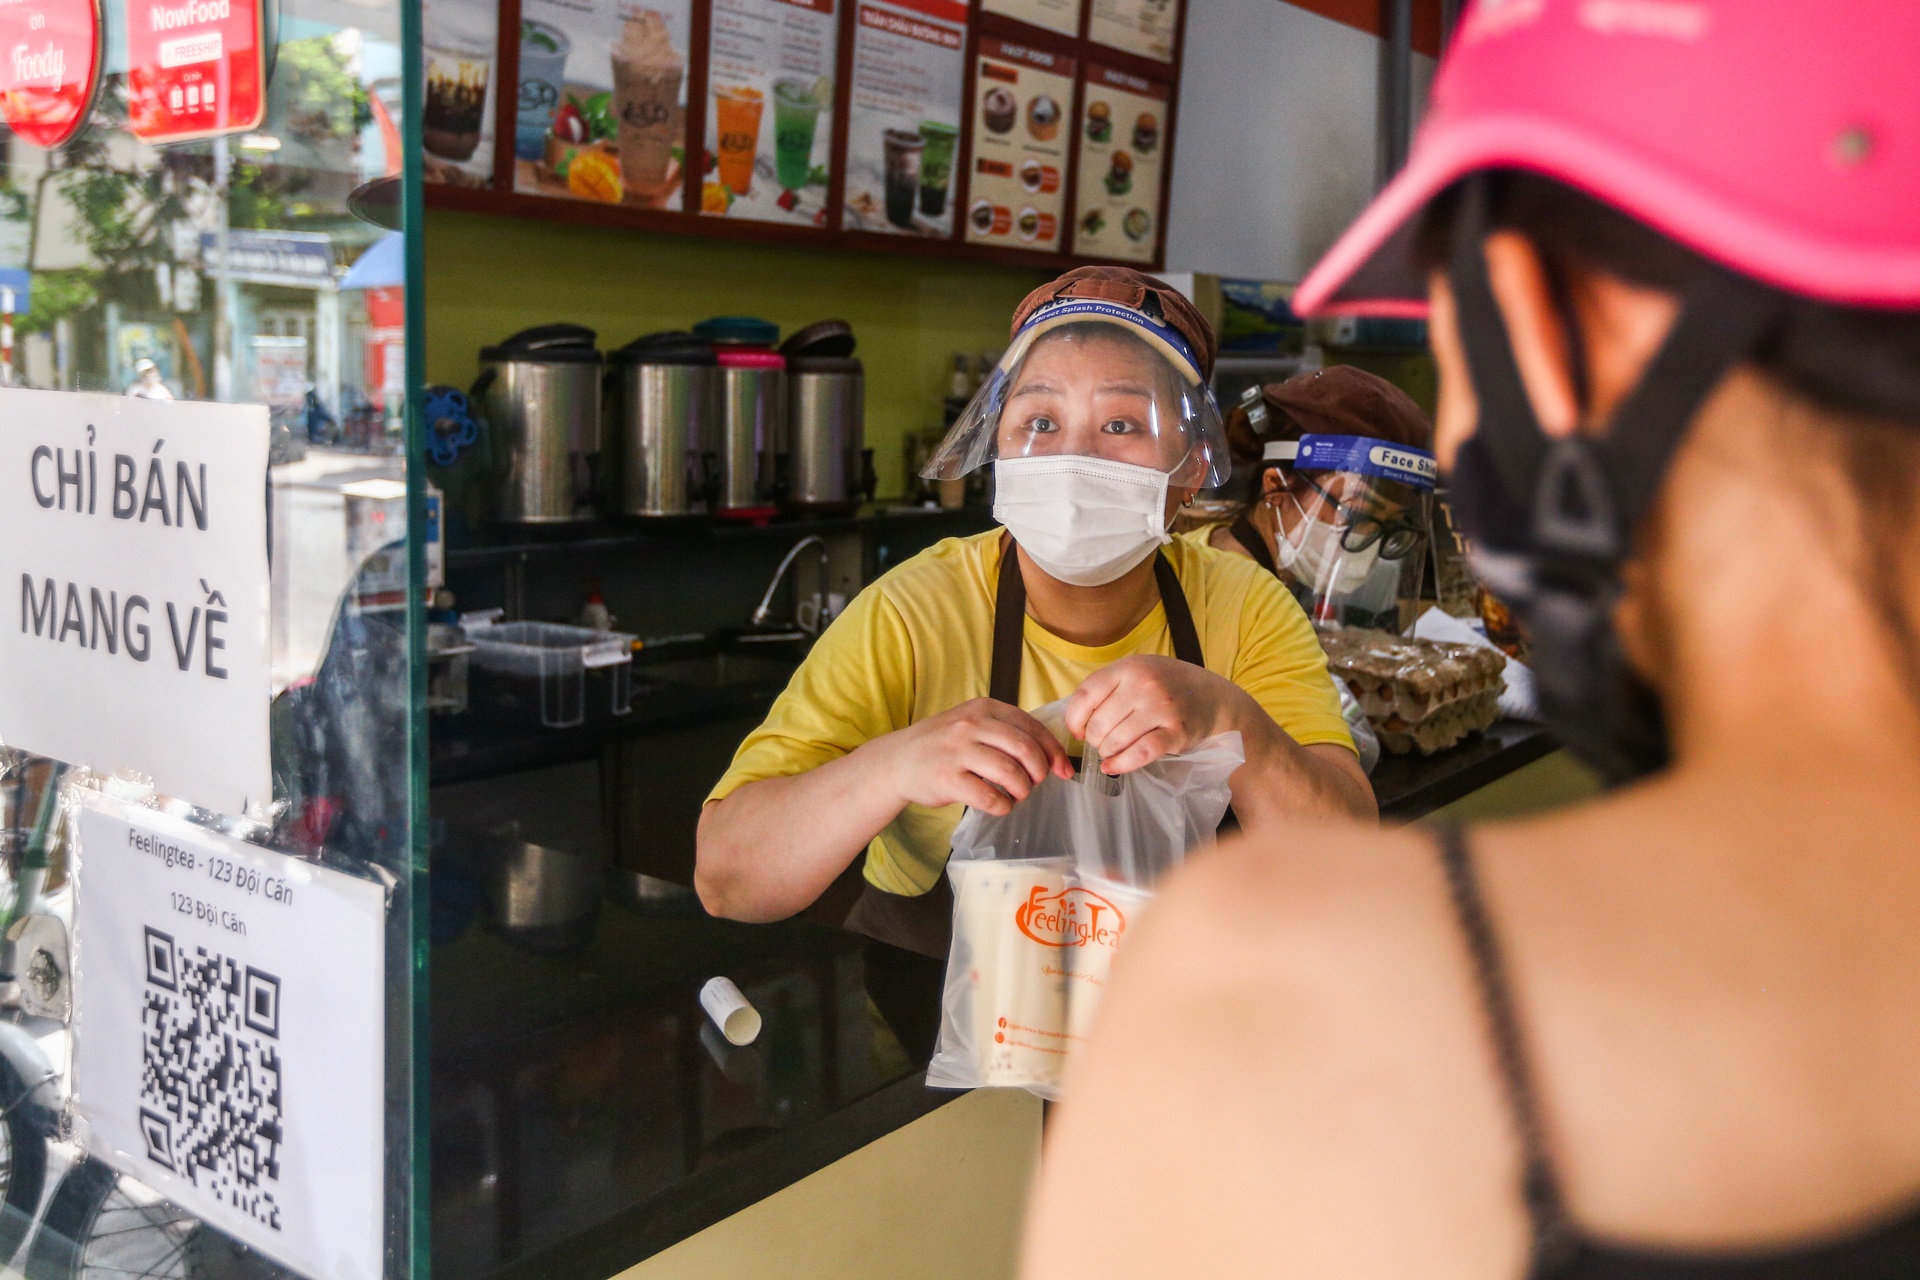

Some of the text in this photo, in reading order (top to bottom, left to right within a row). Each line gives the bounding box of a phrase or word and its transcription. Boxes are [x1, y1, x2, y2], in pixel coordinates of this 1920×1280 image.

[31, 14, 45, 31] on
[152, 0, 230, 32] NowFood
[13, 42, 66, 92] Foody
[175, 40, 220, 59] FREESHIP
[1034, 308, 1060, 323] Direct
[1061, 305, 1093, 315] Splash
[1095, 305, 1144, 325] Protection
[31, 423, 209, 531] CHỈ BÁN
[1381, 450, 1414, 468] Face
[22, 573, 229, 680] MANG VỀ
[129, 828, 195, 870] Feelingtea
[209, 857, 233, 883] 123
[236, 866, 262, 896] Đội
[264, 876, 293, 906] Cấn
[171, 891, 247, 937] 123 Đội Cấn
